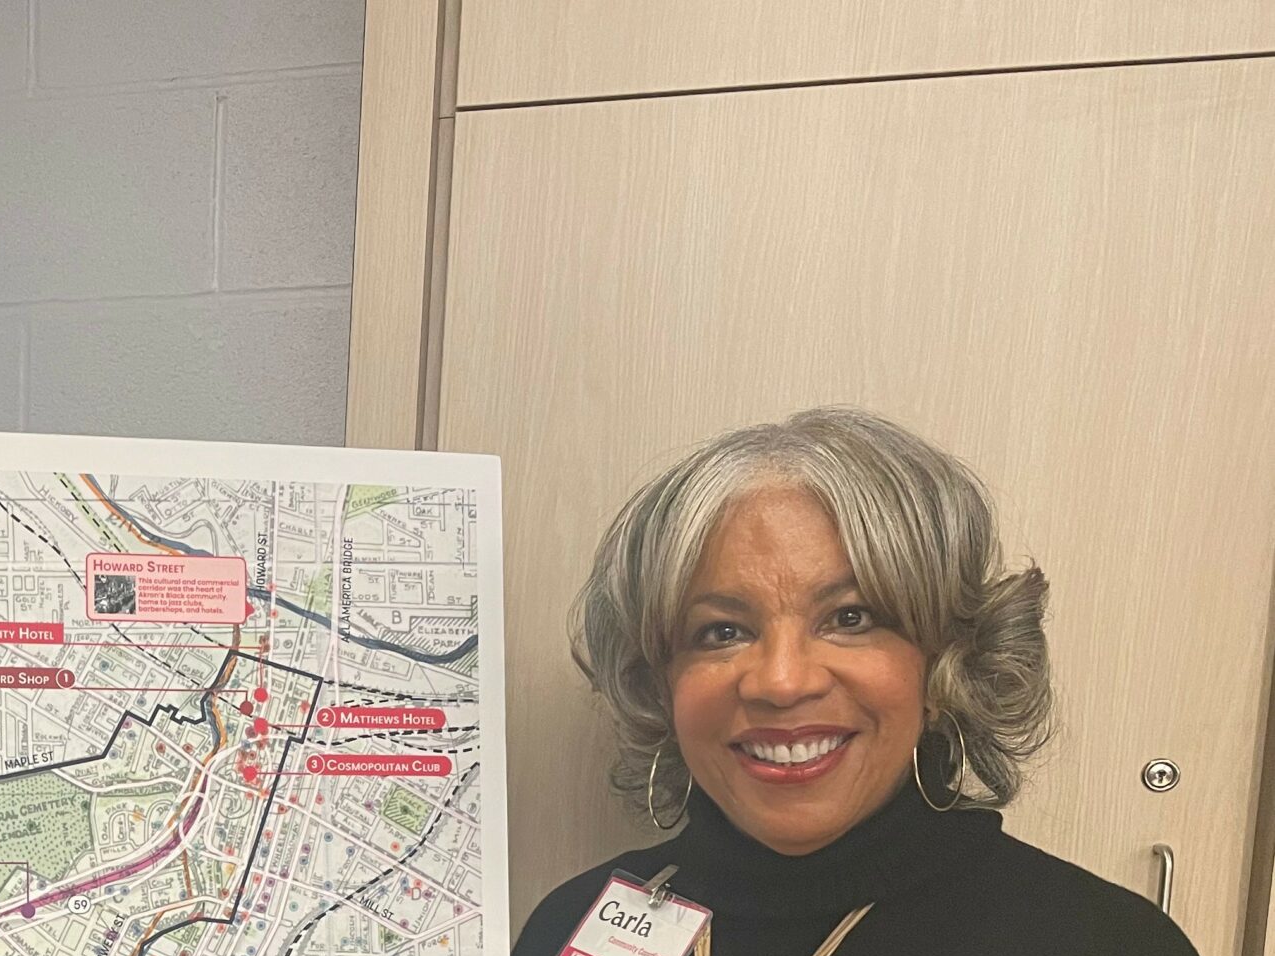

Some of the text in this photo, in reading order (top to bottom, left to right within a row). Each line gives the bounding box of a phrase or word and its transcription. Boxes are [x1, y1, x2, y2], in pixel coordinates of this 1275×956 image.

[258, 532, 267, 546] ST
[63, 673, 69, 683] 1
[322, 714, 329, 722] 2
[4, 751, 54, 770] MAPLE ST
[311, 760, 318, 769] 3
[74, 900, 88, 911] 59
[114, 914, 126, 929] ST
[599, 900, 652, 938] Carla
